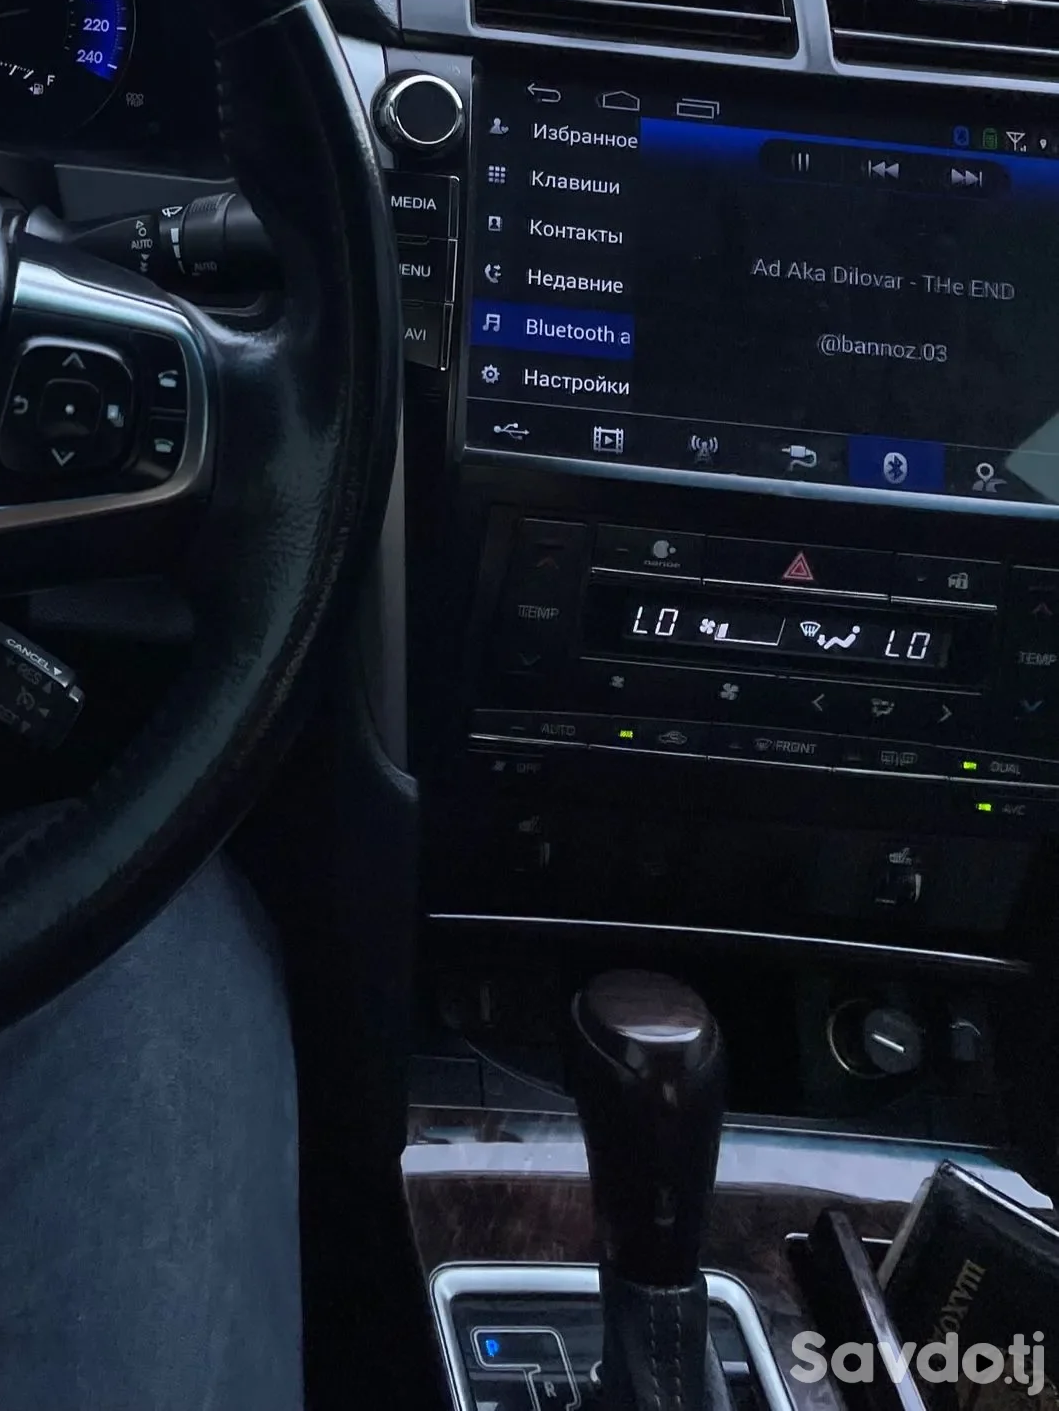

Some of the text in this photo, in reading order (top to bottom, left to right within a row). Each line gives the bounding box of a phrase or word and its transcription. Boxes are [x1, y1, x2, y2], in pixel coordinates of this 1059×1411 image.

[82, 17, 110, 33] 220
[76, 48, 104, 65] 240
[46, 74, 56, 87] F
[532, 122, 639, 150] Избранное
[531, 169, 621, 195] Клавиши
[390, 194, 438, 211] MEDIA
[529, 218, 624, 245] Контакты
[398, 263, 432, 278] ENU
[527, 268, 625, 295] Недавние
[752, 258, 782, 278] Ad
[787, 261, 827, 283] Aka
[832, 265, 905, 291] Dilovar
[970, 279, 1016, 302] END
[403, 327, 427, 341] AVI
[525, 318, 632, 346] Bluetooth a
[523, 368, 631, 396] Настройки
[5, 638, 52, 671] CANCEL
[775, 739, 818, 755] FRONT
